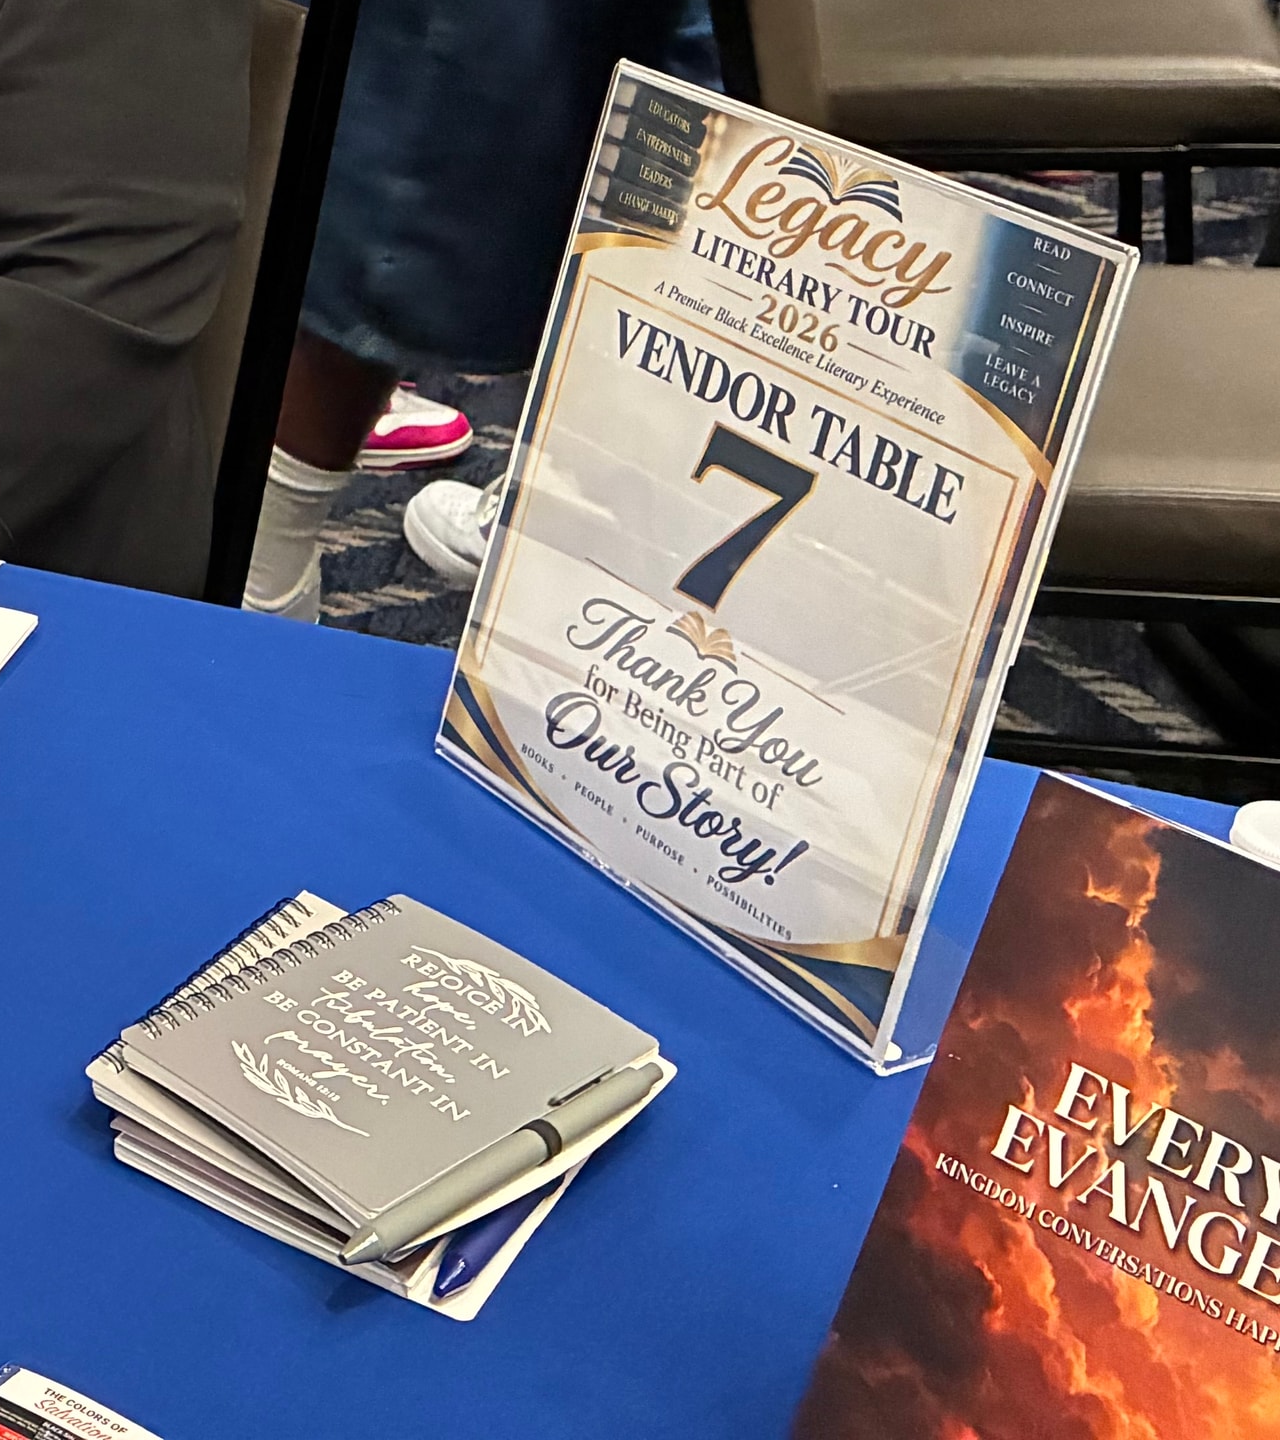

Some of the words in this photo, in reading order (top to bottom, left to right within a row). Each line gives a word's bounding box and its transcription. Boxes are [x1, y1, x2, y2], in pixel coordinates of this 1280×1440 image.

[648, 99, 690, 134] EDUCATORS
[618, 191, 651, 212] CHANGE
[638, 163, 673, 189] LEADERS
[696, 135, 953, 309] Legacy
[1033, 236, 1071, 261] READ
[692, 229, 840, 312] LITERARY
[848, 294, 935, 358] TOUR
[756, 294, 839, 352] 2026
[1006, 271, 1074, 307] CONNECT
[653, 280, 665, 295] A
[666, 285, 713, 316] Premier
[713, 306, 748, 334] Black
[749, 323, 814, 364] Excellence
[815, 353, 869, 391] Literary
[870, 379, 945, 425] Experience
[999, 314, 1054, 345] INSPIRE
[983, 371, 1035, 404] LEGACY
[985, 352, 1028, 381] LEAVE
[1031, 375, 1040, 388] A
[618, 311, 795, 440] VENDOR
[811, 406, 963, 522] TABLE
[673, 420, 819, 614] 7
[566, 597, 717, 718] Thank
[714, 677, 824, 788] You
[583, 664, 619, 703] for
[623, 689, 691, 759] Being
[695, 735, 746, 791] Part
[751, 781, 784, 811] of
[545, 691, 641, 785] Our
[636, 761, 811, 886] Story!
[520, 743, 554, 774] BOOKS
[574, 781, 613, 816] PEOPLE
[635, 824, 684, 866] PURPOSE
[706, 875, 792, 945] POSSIBILITIES
[330, 969, 367, 991] BE
[364, 987, 473, 1053] PATIENT
[468, 1052, 510, 1079] IN
[400, 953, 503, 1014] REJOICE
[500, 1010, 541, 1037] IN
[402, 976, 476, 1030] hope,
[262, 990, 298, 1012] BE
[297, 1009, 433, 1094] CONSTANT
[429, 1094, 471, 1121] IN
[263, 1030, 389, 1105] prayer.
[311, 987, 454, 1083] tribulation,
[275, 1058, 317, 1087] ROMANS
[315, 1084, 340, 1102] 12:12
[934, 1151, 1038, 1218] KINGDOM
[1037, 1206, 1226, 1321] CONVERSATIONS
[33, 1398, 114, 1440] Salvation
[43, 1387, 67, 1404] THE
[65, 1398, 111, 1426] COLORS
[109, 1422, 130, 1435] OF
